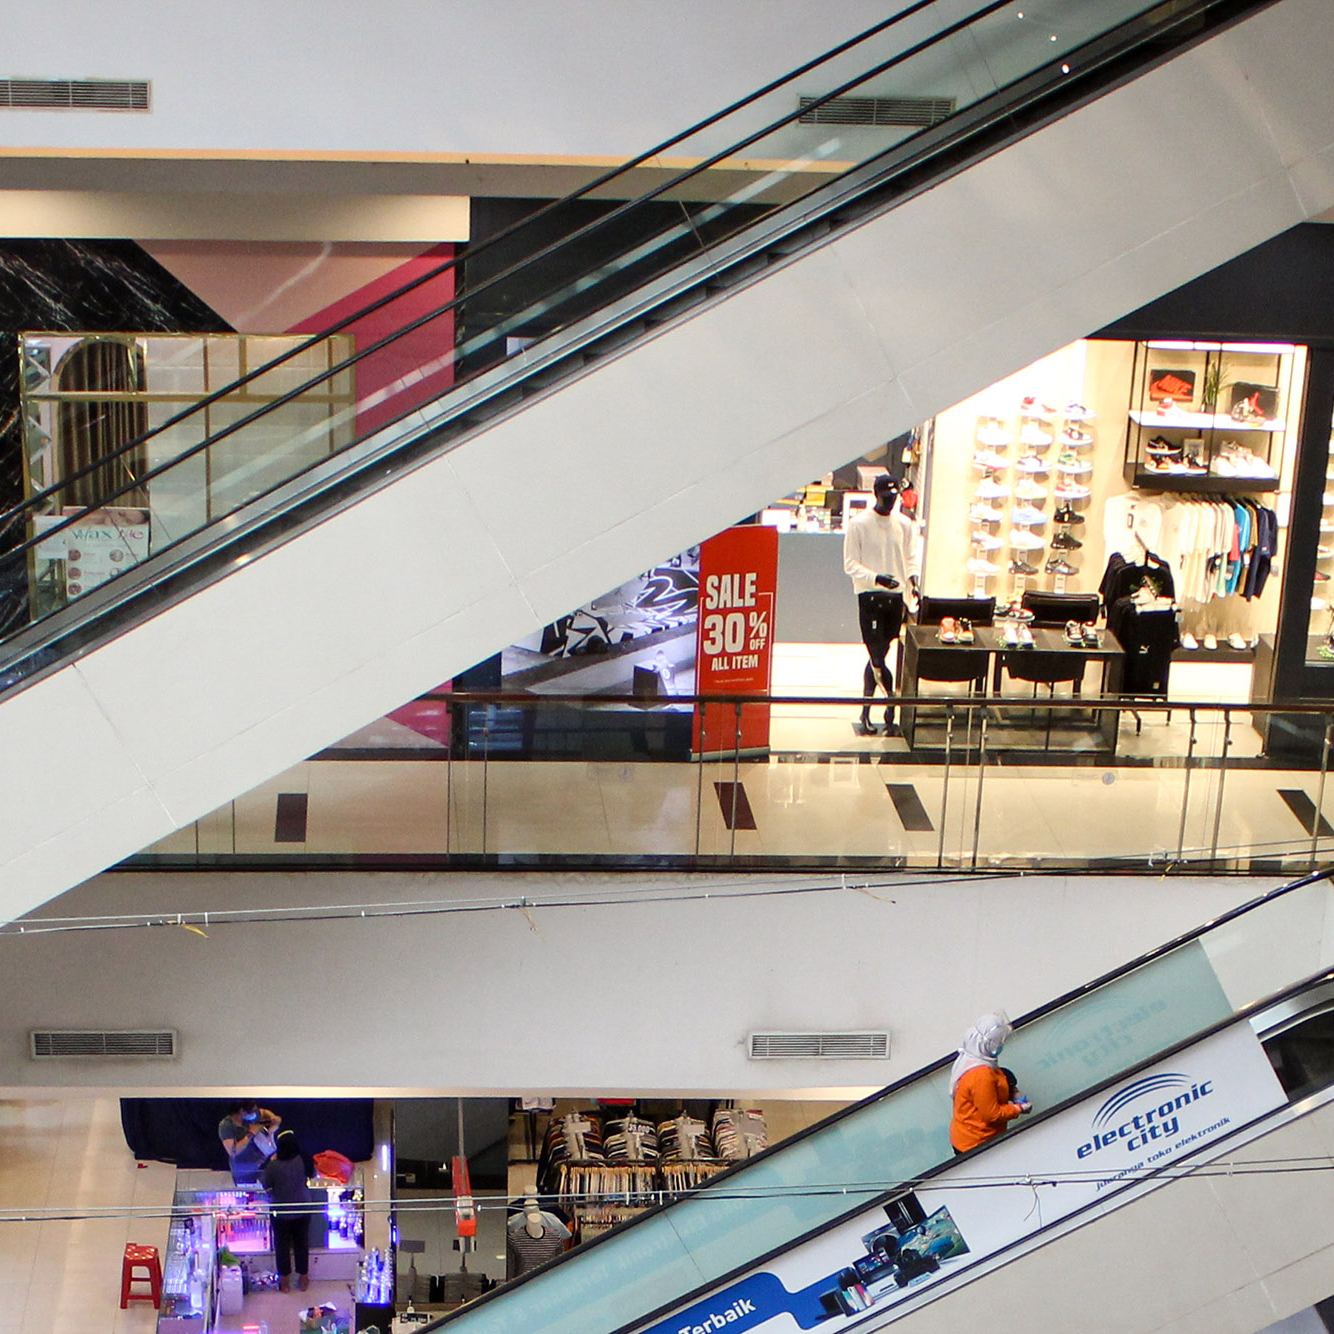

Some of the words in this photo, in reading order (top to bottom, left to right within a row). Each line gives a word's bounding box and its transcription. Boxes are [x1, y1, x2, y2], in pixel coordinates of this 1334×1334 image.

[1158, 375, 1192, 396] NIKE
[705, 573, 757, 610] SALE
[703, 611, 768, 655] 30%
[749, 638, 766, 651] OFF
[711, 656, 729, 671] ALL
[732, 654, 759, 669] ITEM
[1077, 1080, 1214, 1159] electronic
[1127, 1116, 1181, 1152] city
[1147, 1146, 1173, 1164] toko
[1175, 1116, 1231, 1149] elektronik
